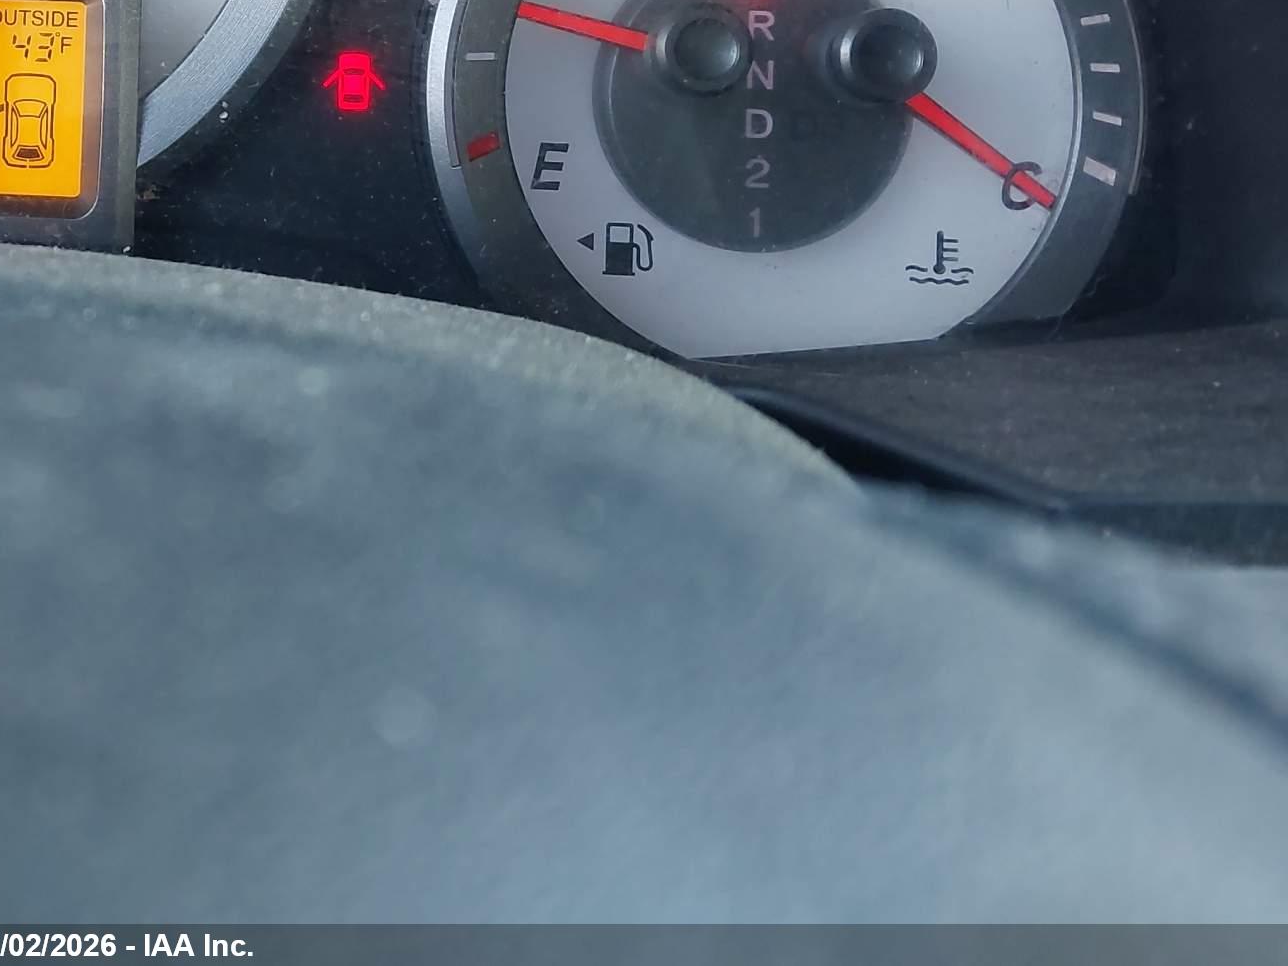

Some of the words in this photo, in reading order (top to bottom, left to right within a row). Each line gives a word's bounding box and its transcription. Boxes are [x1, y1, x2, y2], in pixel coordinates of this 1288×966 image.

[746, 10, 775, 41] R
[746, 61, 774, 91] N
[744, 108, 774, 139] D
[531, 142, 569, 191] E
[745, 159, 771, 189] 2
[1001, 160, 1042, 211] C
[749, 208, 760, 237] 1
